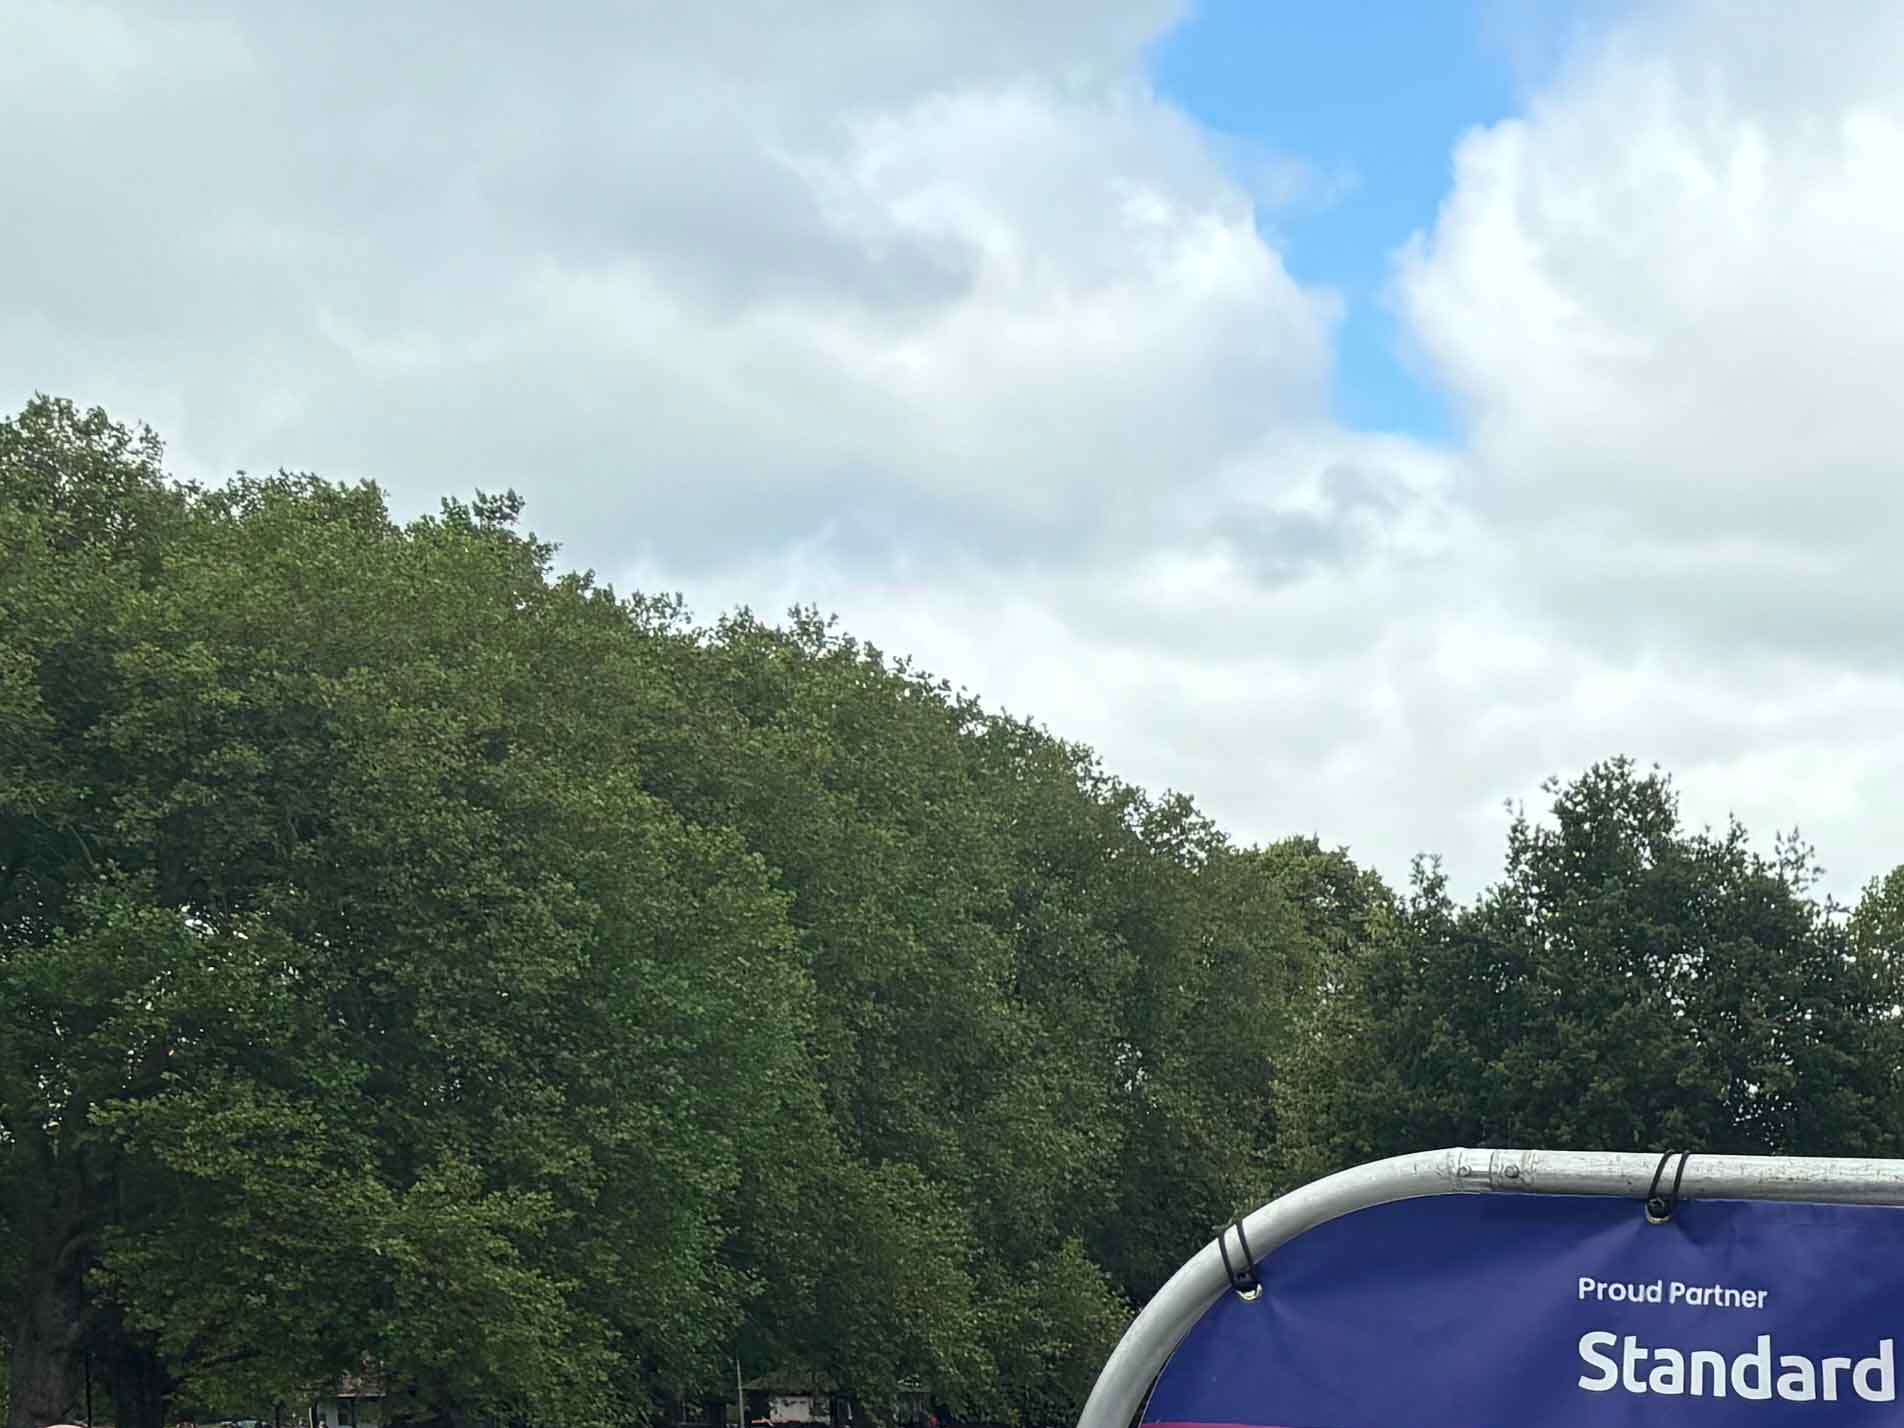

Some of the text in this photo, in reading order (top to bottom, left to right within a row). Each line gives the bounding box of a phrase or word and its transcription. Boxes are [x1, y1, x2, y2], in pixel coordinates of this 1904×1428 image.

[1578, 1277, 1768, 1308] Proud Partner
[1578, 1331, 1895, 1402] Standard
